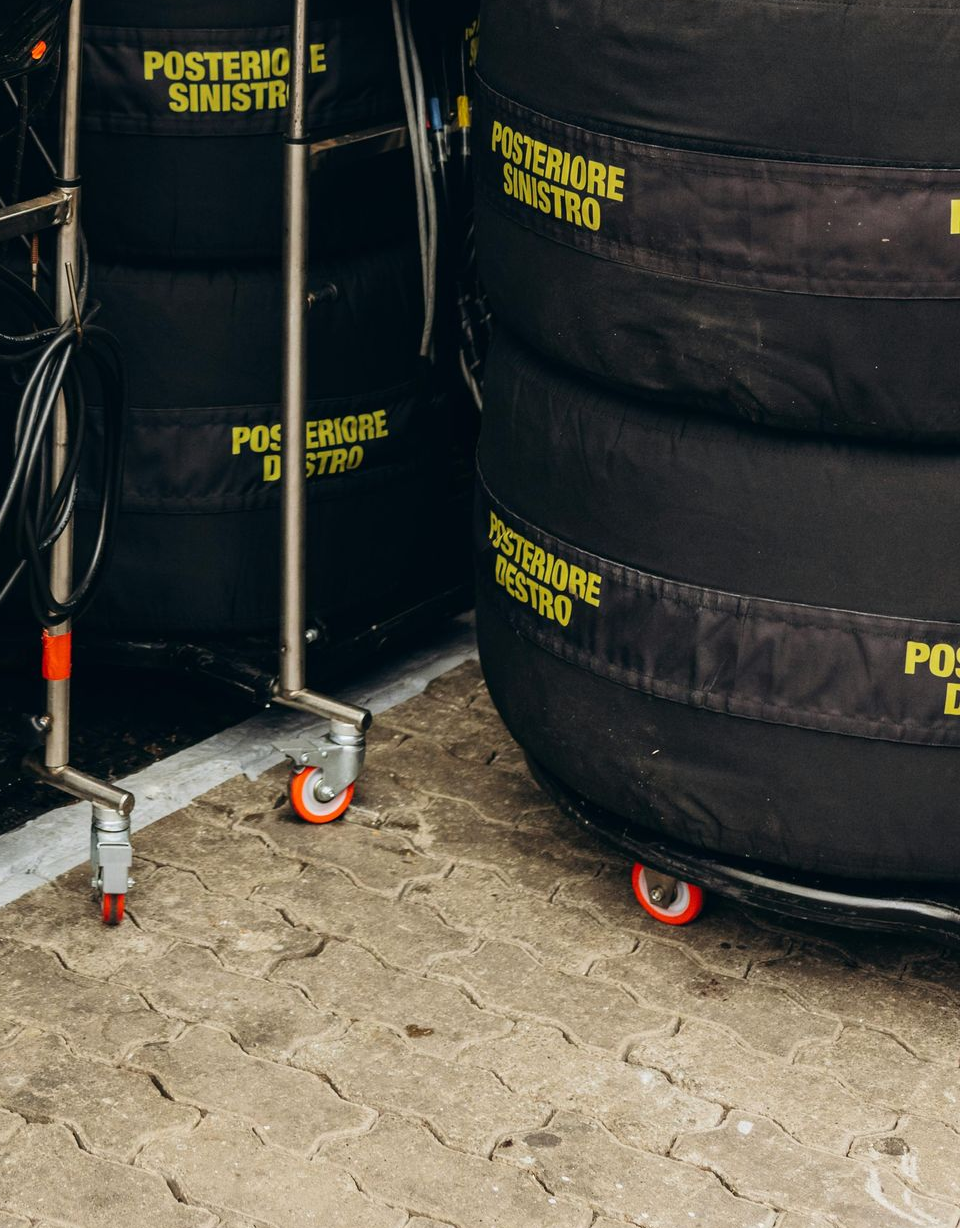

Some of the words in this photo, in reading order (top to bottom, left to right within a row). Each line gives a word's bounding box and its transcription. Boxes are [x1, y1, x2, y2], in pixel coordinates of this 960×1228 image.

[143, 43, 326, 82] POSTERIOE
[168, 80, 290, 113] SINISTR
[491, 120, 625, 202] POSTERIORE
[502, 166, 600, 231] SINISTRO
[232, 409, 389, 455] POSERIORE
[263, 445, 364, 482] DSTRO
[488, 509, 602, 608] POSTERIORE
[495, 554, 573, 627] DESTRO
